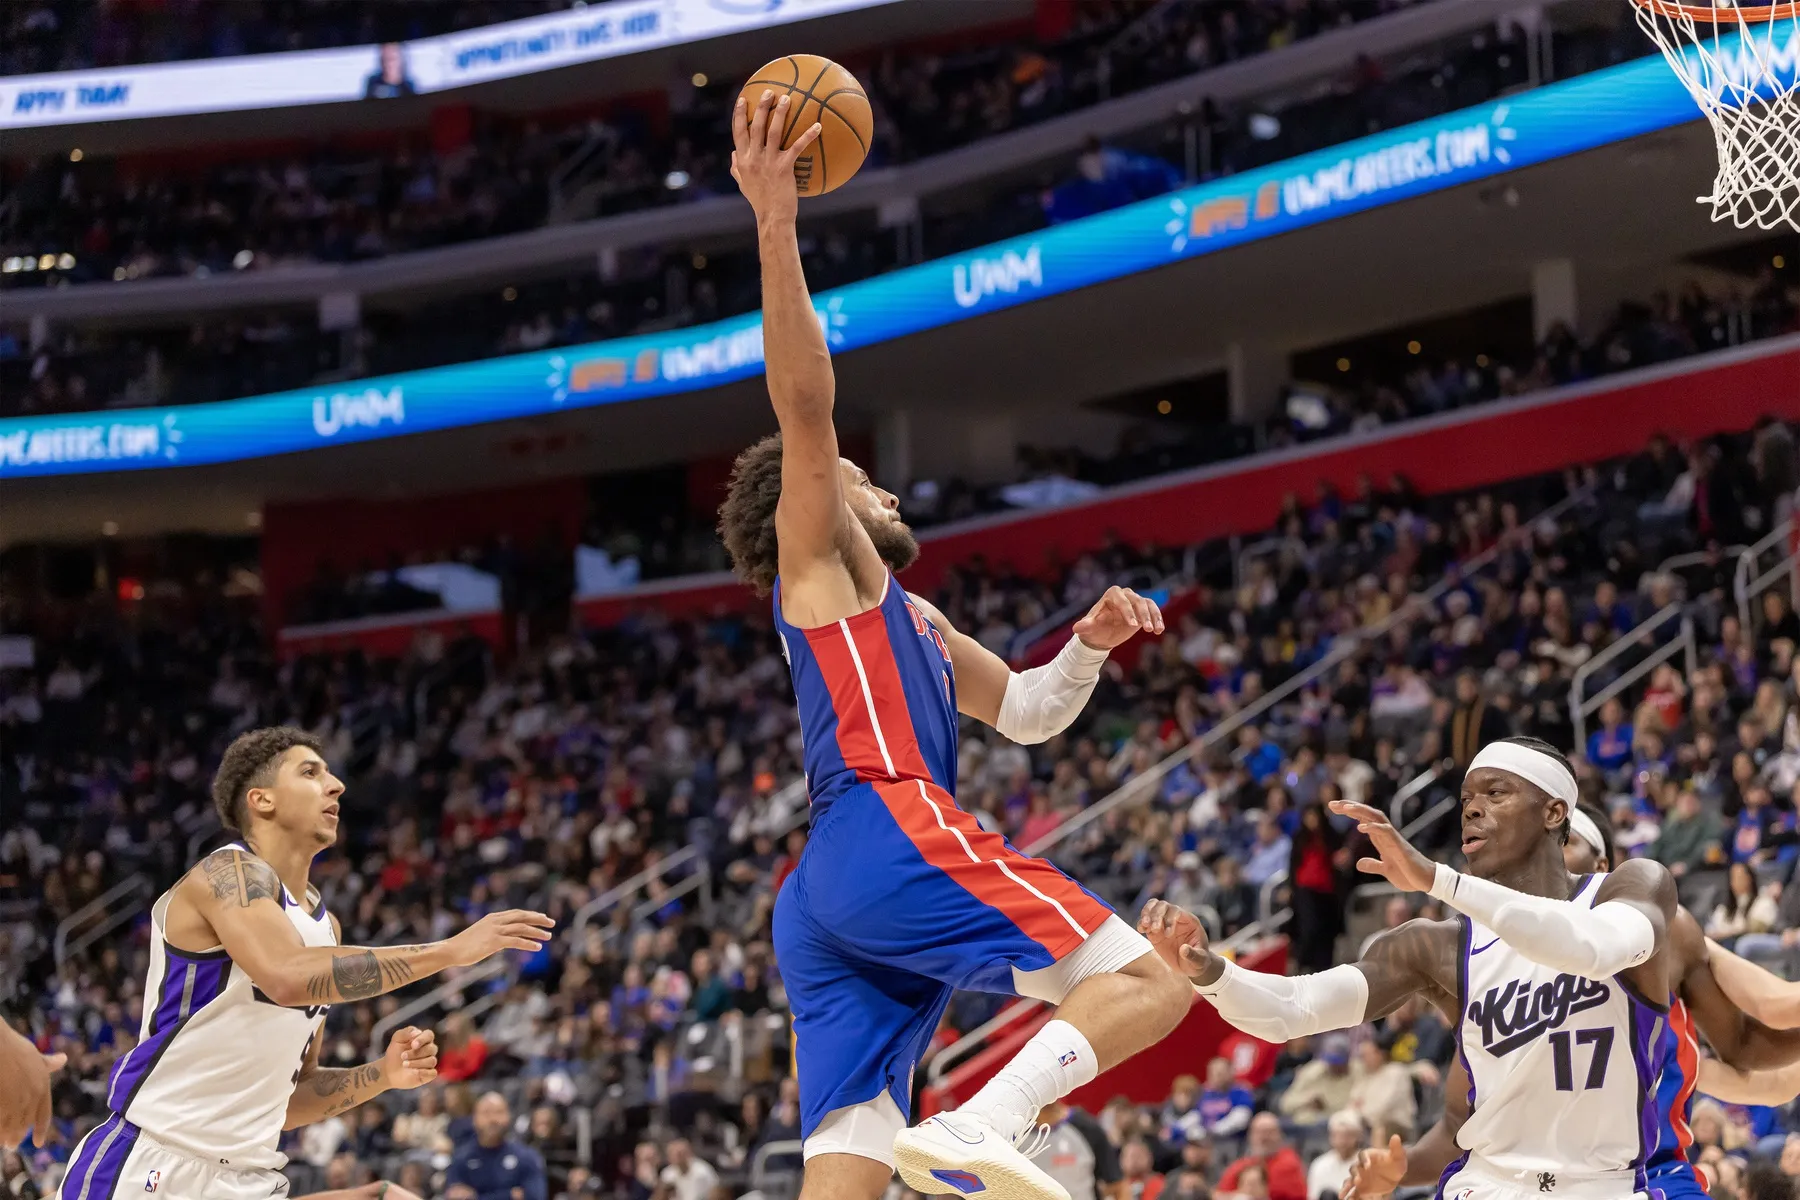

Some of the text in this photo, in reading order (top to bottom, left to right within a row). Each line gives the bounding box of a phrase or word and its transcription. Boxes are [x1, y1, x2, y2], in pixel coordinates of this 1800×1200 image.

[953, 243, 1042, 308] UWM
[312, 385, 404, 436] UWM
[1548, 1026, 1615, 1092] 17
